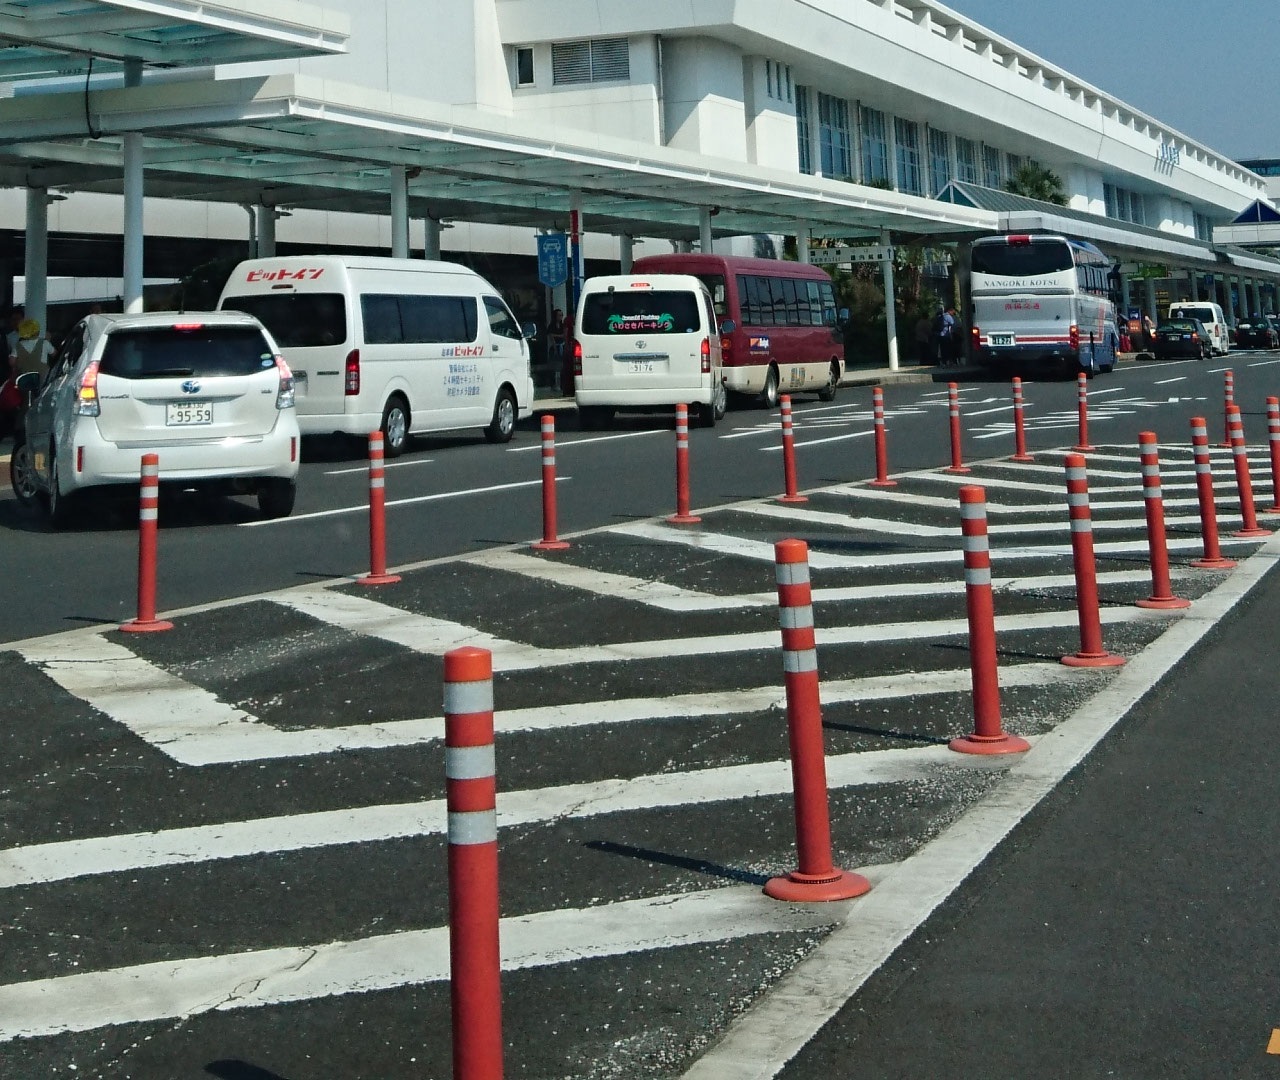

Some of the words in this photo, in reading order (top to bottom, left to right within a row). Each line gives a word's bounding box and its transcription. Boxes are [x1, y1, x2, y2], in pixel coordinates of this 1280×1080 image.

[246, 268, 325, 282] ピットイン
[455, 345, 484, 357] ピットイン
[177, 410, 211, 423] 95-59
